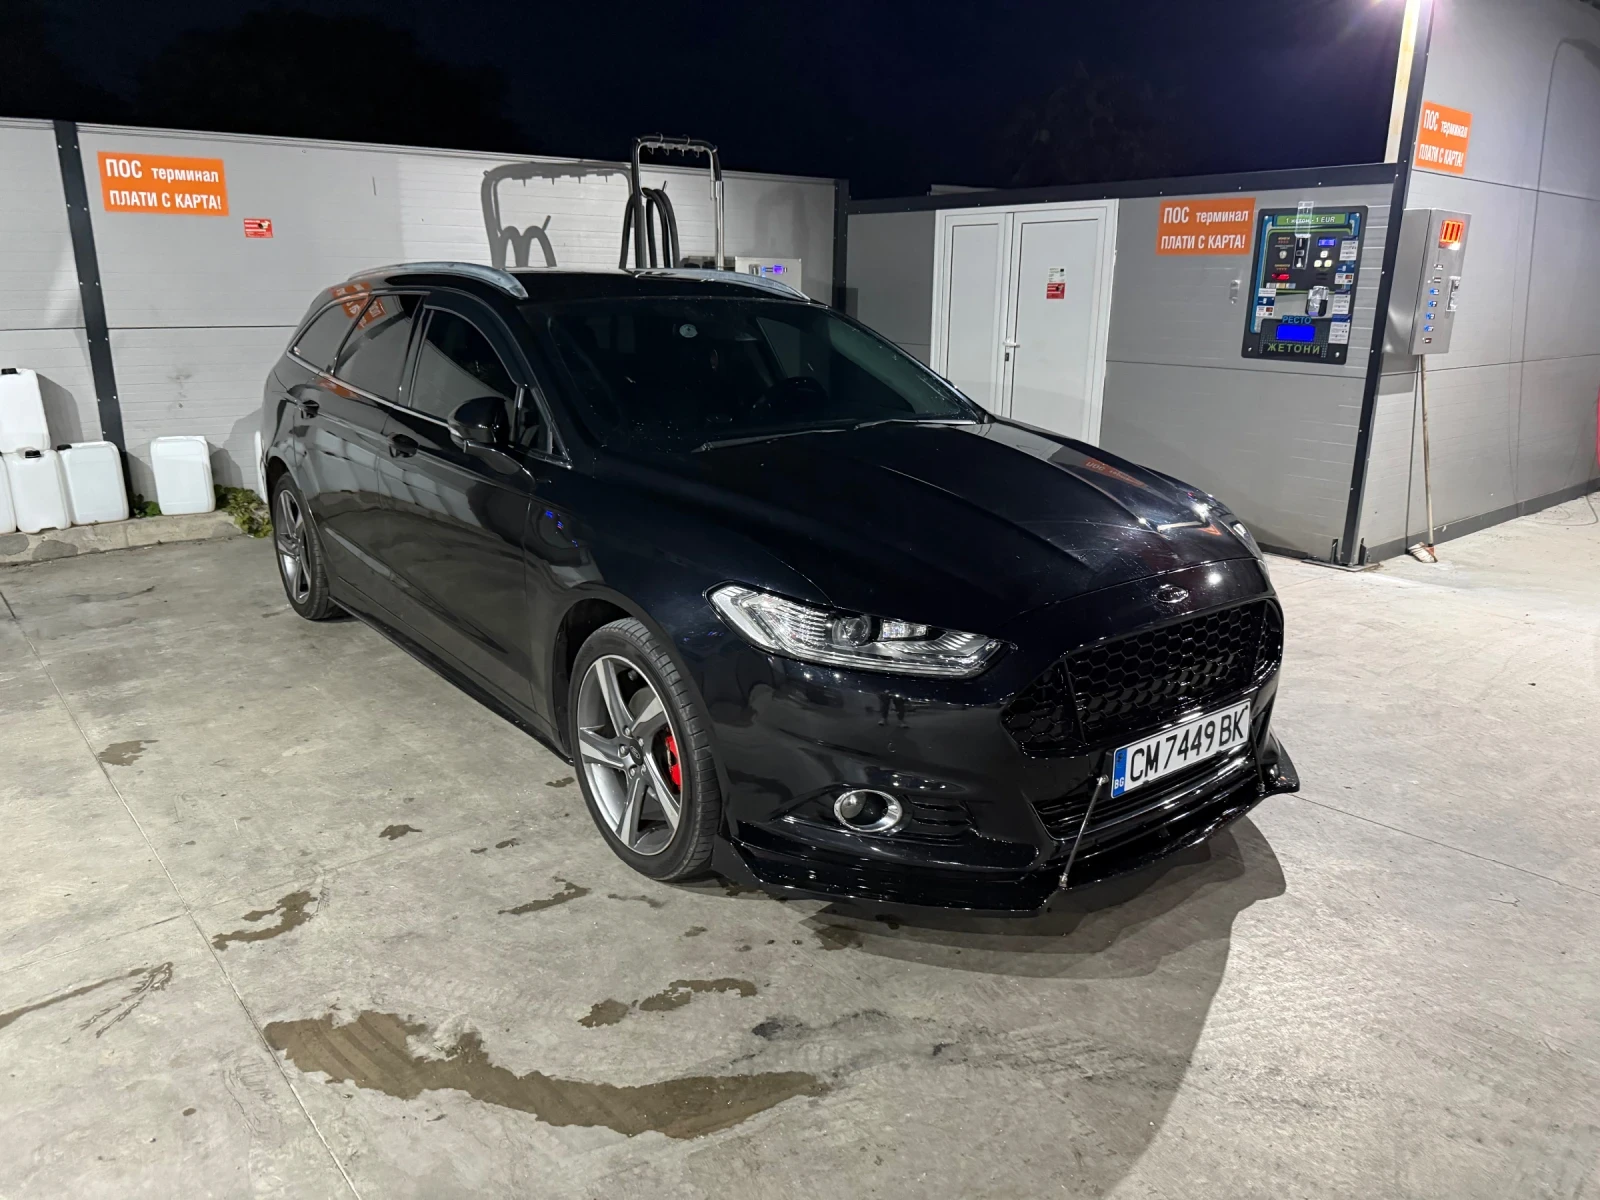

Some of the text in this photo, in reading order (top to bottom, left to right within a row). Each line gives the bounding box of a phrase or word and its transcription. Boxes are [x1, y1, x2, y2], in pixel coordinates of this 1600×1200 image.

[1423, 109, 1469, 138] ПОС терминал
[1418, 144, 1464, 167] ПЛАТИ С КАРТА!
[105, 158, 219, 183] ПОС терминал
[109, 189, 222, 210] ПЛАТИ С КАРТА!
[1163, 206, 1249, 226] ПОС терминал
[1160, 234, 1246, 250] ПЛАТИ С КАРТА!
[1282, 316, 1312, 325] РЕСТО
[1267, 343, 1320, 355] ЖЕТОНИ
[1114, 777, 1125, 790] BG
